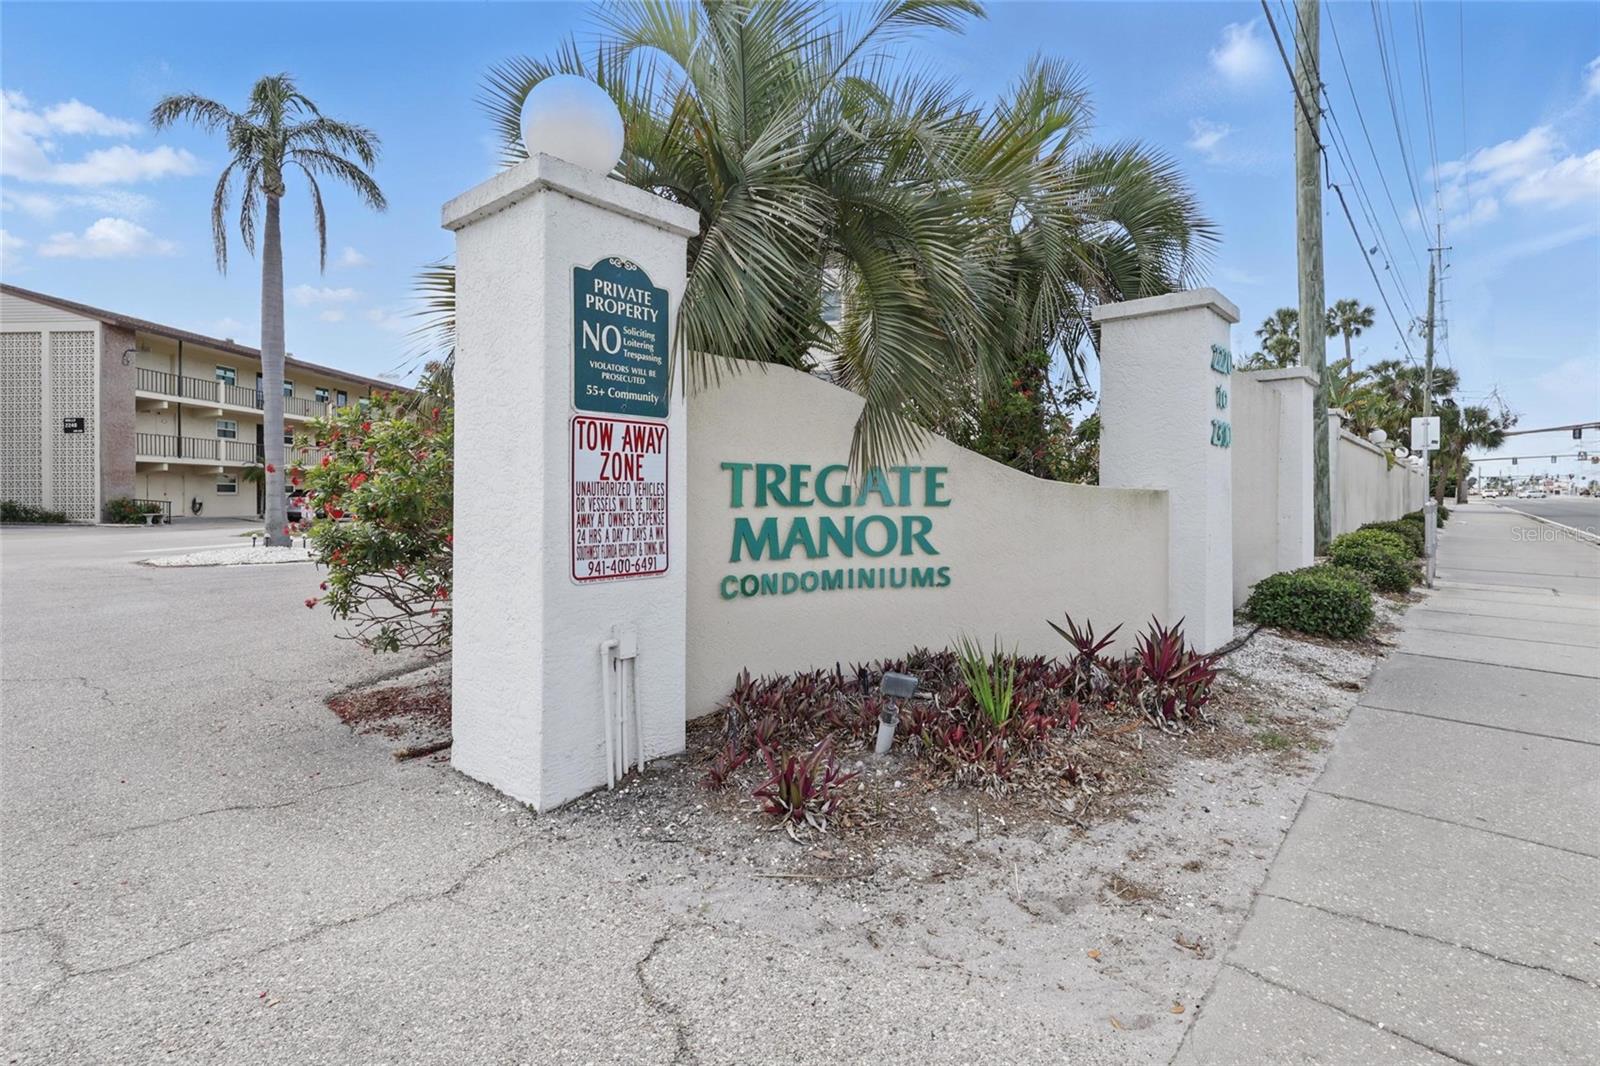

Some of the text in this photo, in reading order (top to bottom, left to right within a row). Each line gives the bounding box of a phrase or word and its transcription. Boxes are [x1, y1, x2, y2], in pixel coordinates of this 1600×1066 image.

[594, 278, 652, 306] PRIVATE
[586, 294, 659, 323] PROPERTY
[582, 320, 622, 354] NO
[623, 326, 656, 342] Soliciting
[623, 338, 654, 352] Loitering
[623, 350, 662, 366] Trespassing
[590, 360, 656, 378] VIOLATORS WILL BE
[602, 372, 646, 385] PROSECUTED
[586, 384, 659, 406] 55+ Community
[576, 420, 664, 454] TOW AWAY
[600, 452, 644, 481] ZONE
[576, 482, 664, 496] UNAUTHORIZED VEHICLES
[720, 462, 952, 508] TREGATE
[576, 497, 664, 512] OR VESSELS WILL BE TOWED
[576, 512, 664, 528] AWAY AT OWNERS EXPENSE
[577, 527, 664, 544] 24 HRS A DAY 7 DAYS A WK
[728, 514, 940, 563] MANOR
[588, 556, 658, 576] 941-400-6491
[720, 566, 952, 600] CONDOMINIUMS
